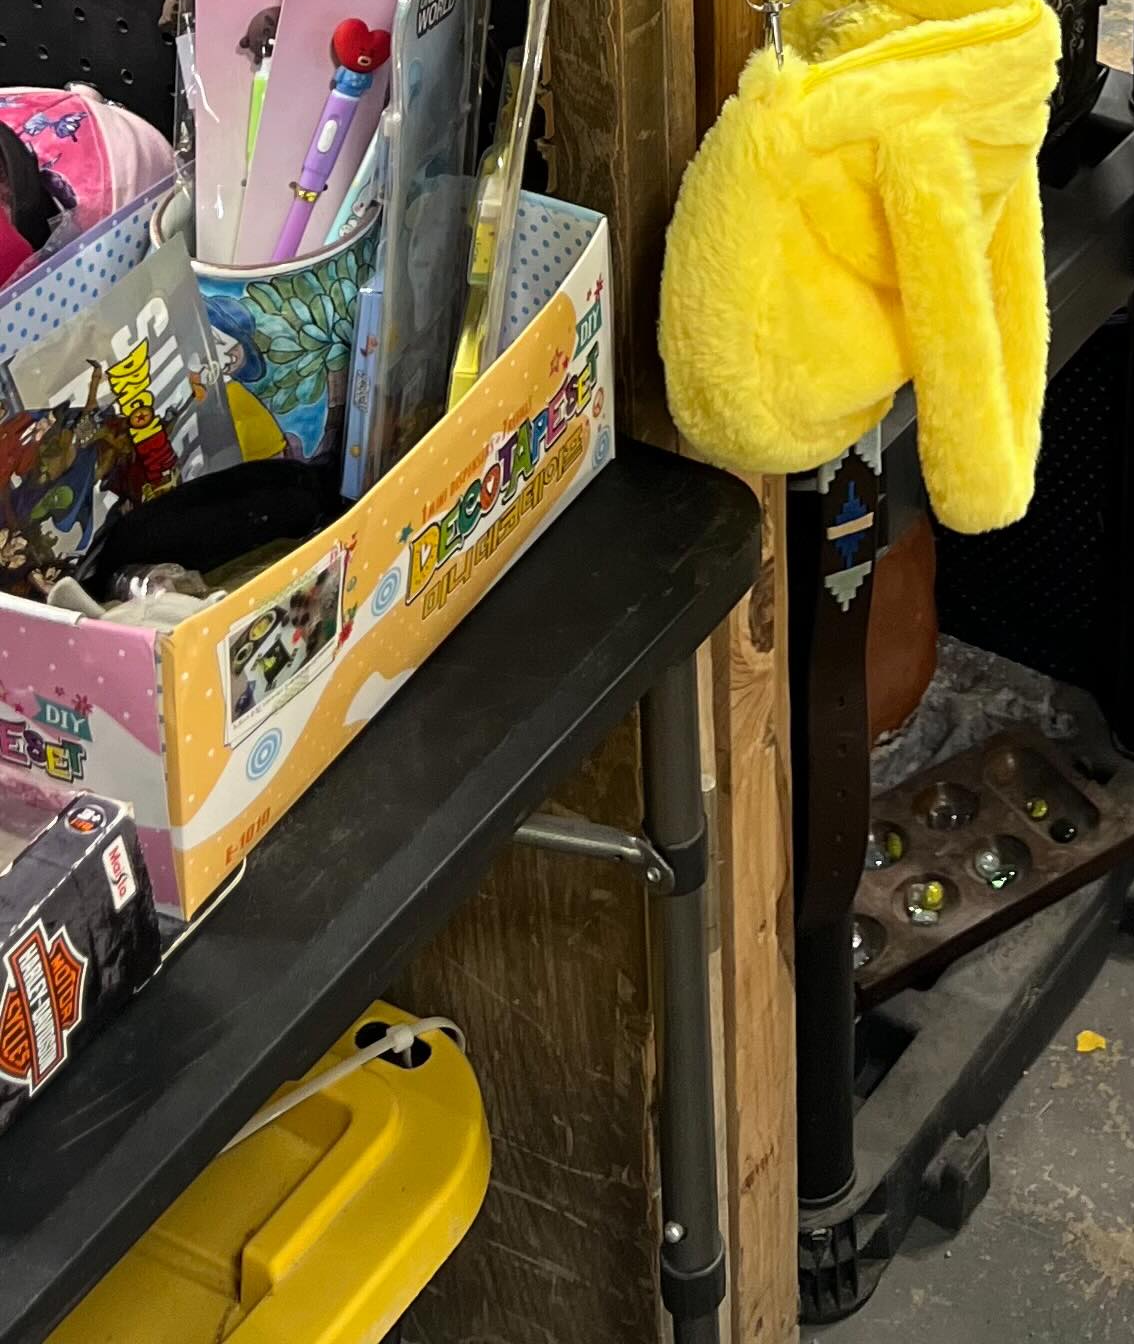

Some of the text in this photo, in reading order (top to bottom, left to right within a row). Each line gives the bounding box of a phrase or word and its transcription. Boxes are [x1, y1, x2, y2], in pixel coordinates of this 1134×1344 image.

[580, 305, 600, 346] DIY
[106, 337, 162, 444] DRAGON
[45, 703, 85, 734] DIY
[19, 942, 57, 1075] HARLEY-DAVIDSON
[50, 952, 76, 1021] MOTOR
[1, 997, 31, 1067] CYCLES
